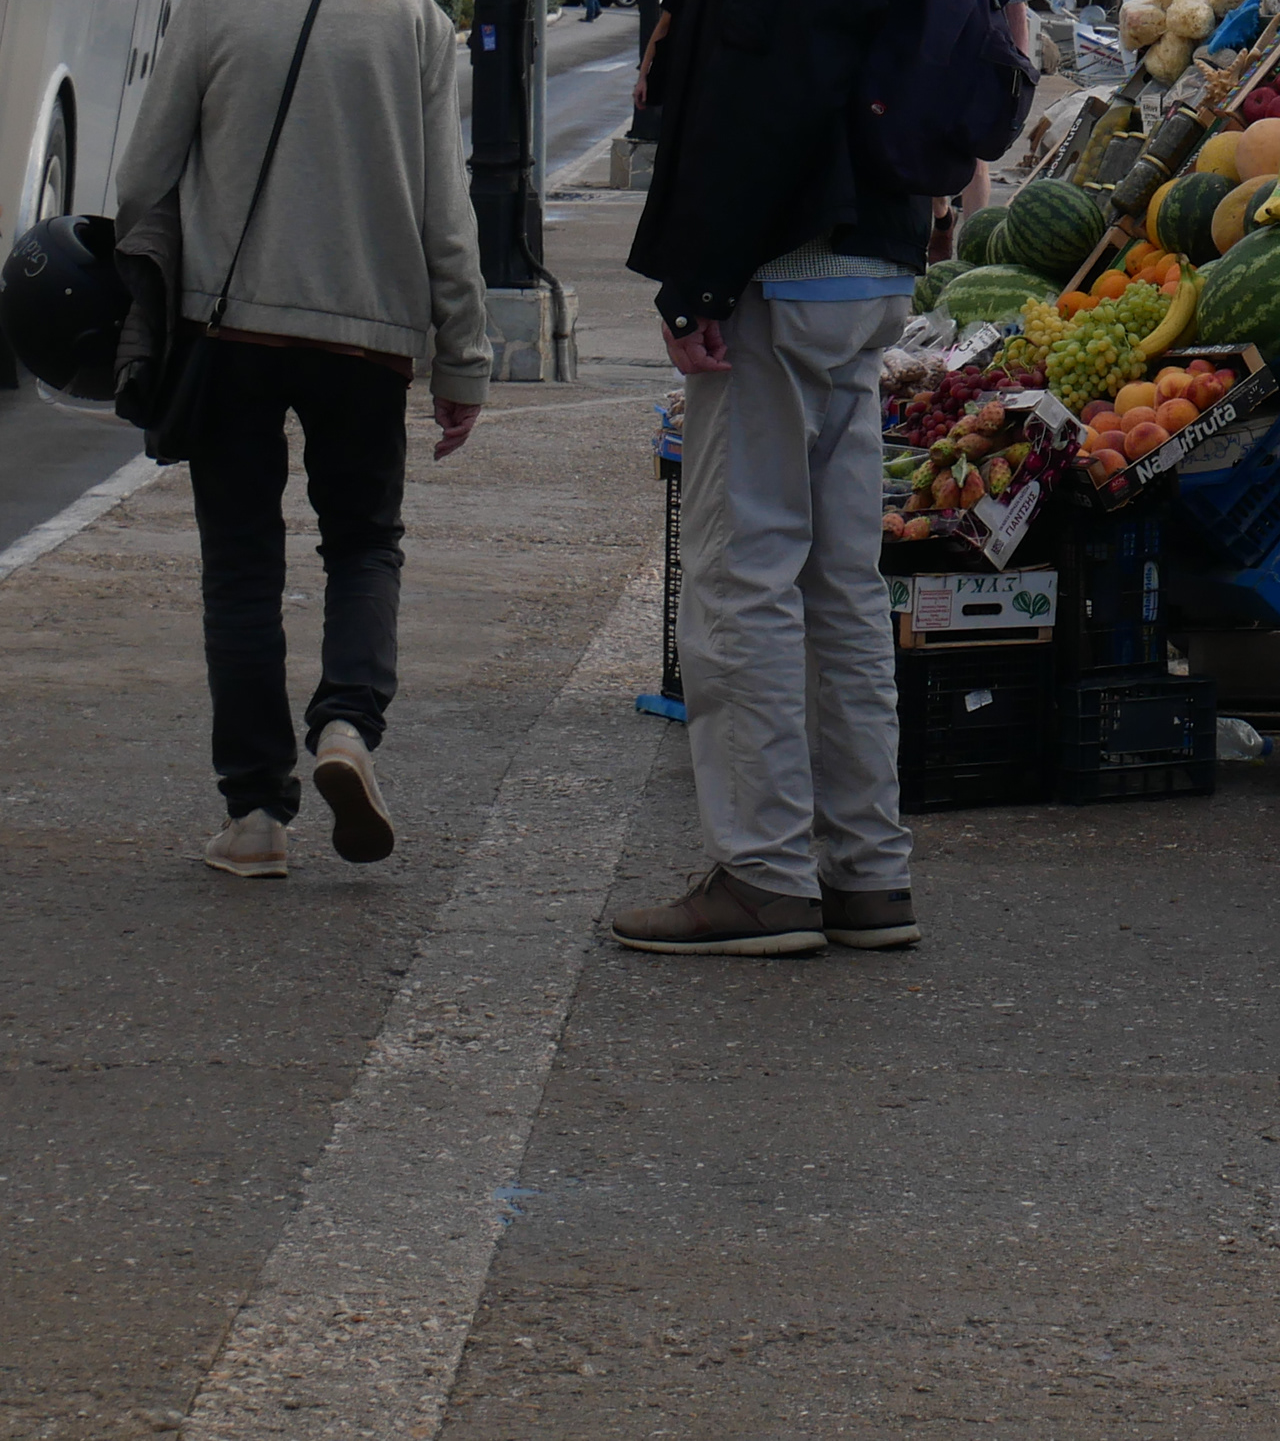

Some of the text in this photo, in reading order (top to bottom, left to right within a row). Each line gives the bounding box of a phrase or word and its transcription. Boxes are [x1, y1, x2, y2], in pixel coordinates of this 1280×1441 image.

[1135, 403, 1237, 485] Naufruta
[1005, 491, 1038, 537] ΓΙΑΝΤΣΗΣ
[956, 576, 1018, 594] ΣΥΚΑ
